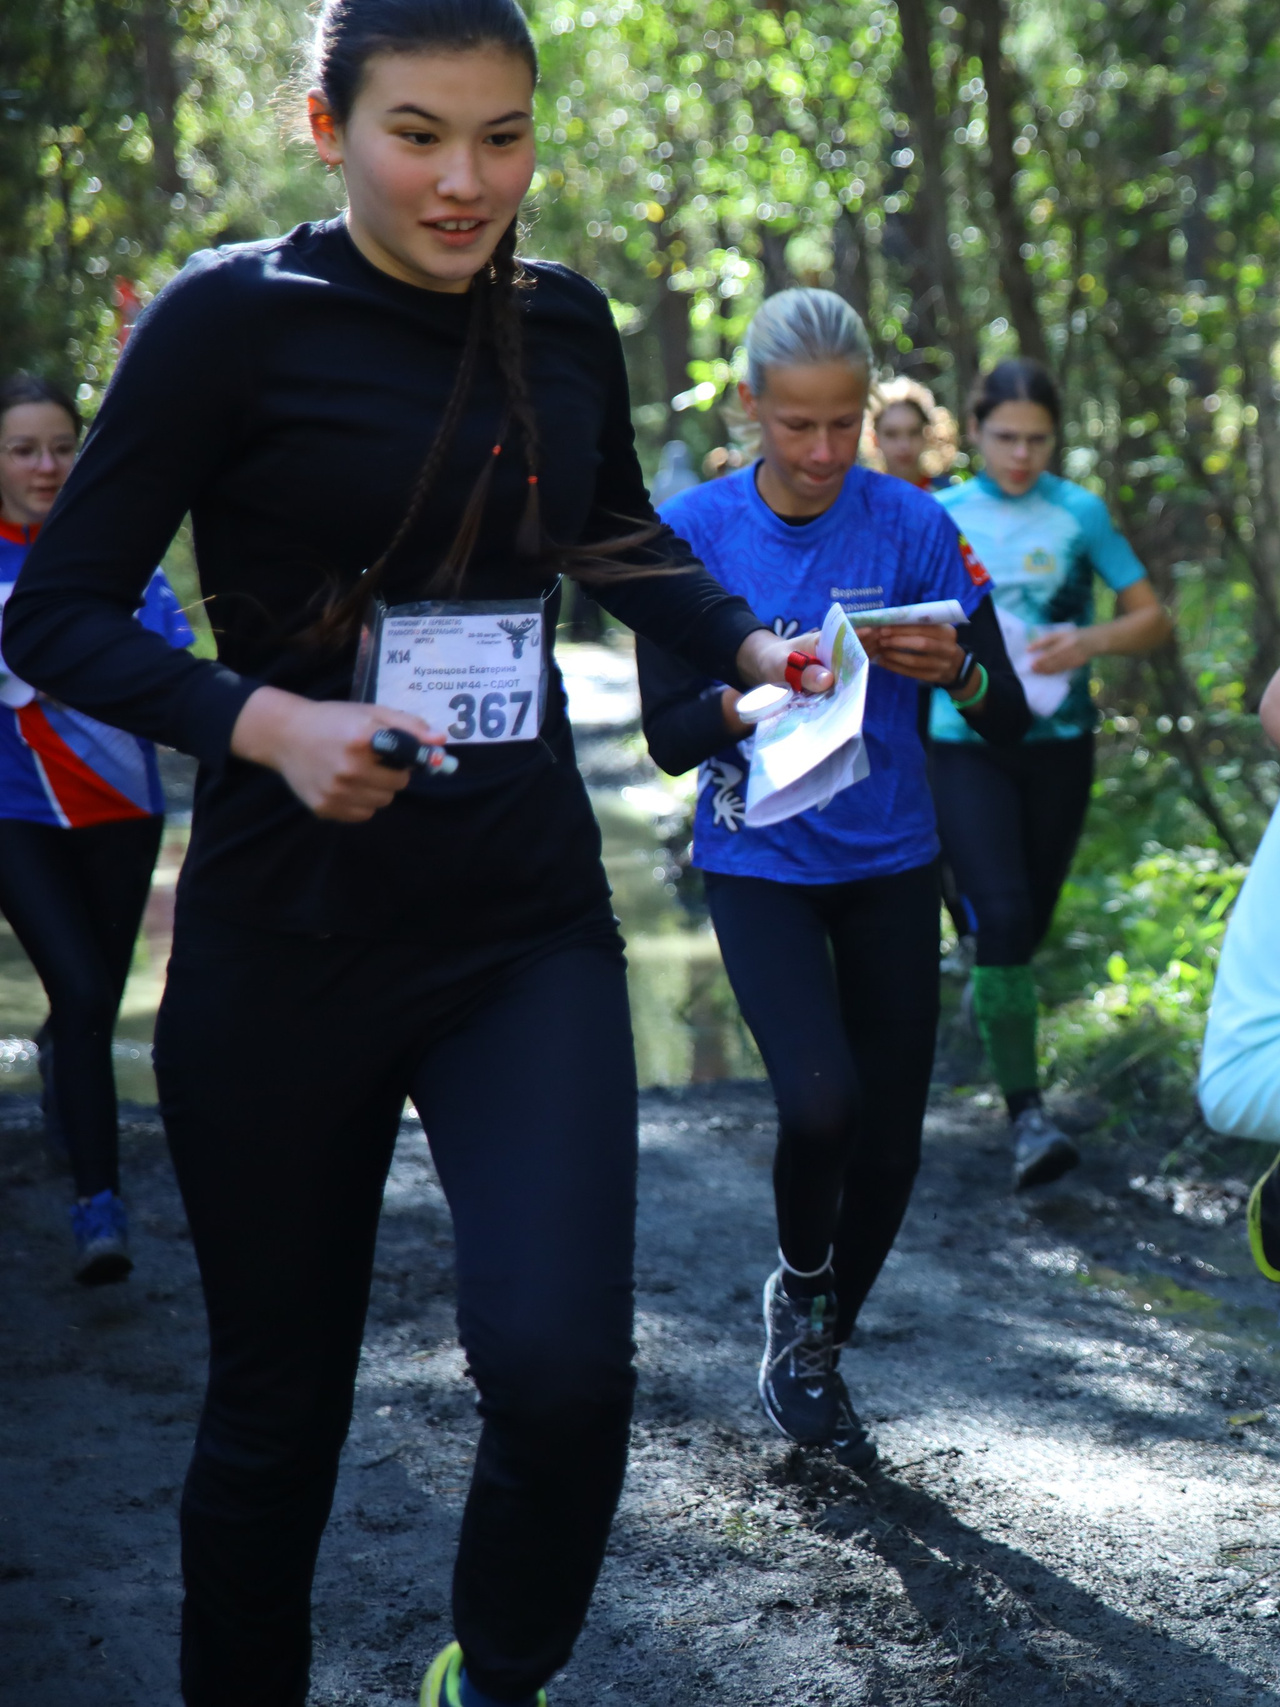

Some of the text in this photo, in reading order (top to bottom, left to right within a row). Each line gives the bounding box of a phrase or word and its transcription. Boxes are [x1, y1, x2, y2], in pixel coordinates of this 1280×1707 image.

[830, 586, 884, 600] Воронина
[421, 627, 464, 636] ФЕДЕРАЛЬНОГО
[387, 649, 411, 664] Ж14
[414, 665, 517, 676] Кузнецова Екатерина
[408, 680, 454, 692] 45_СОШ
[490, 679, 520, 689] СДЮТ
[447, 691, 533, 740] 367
